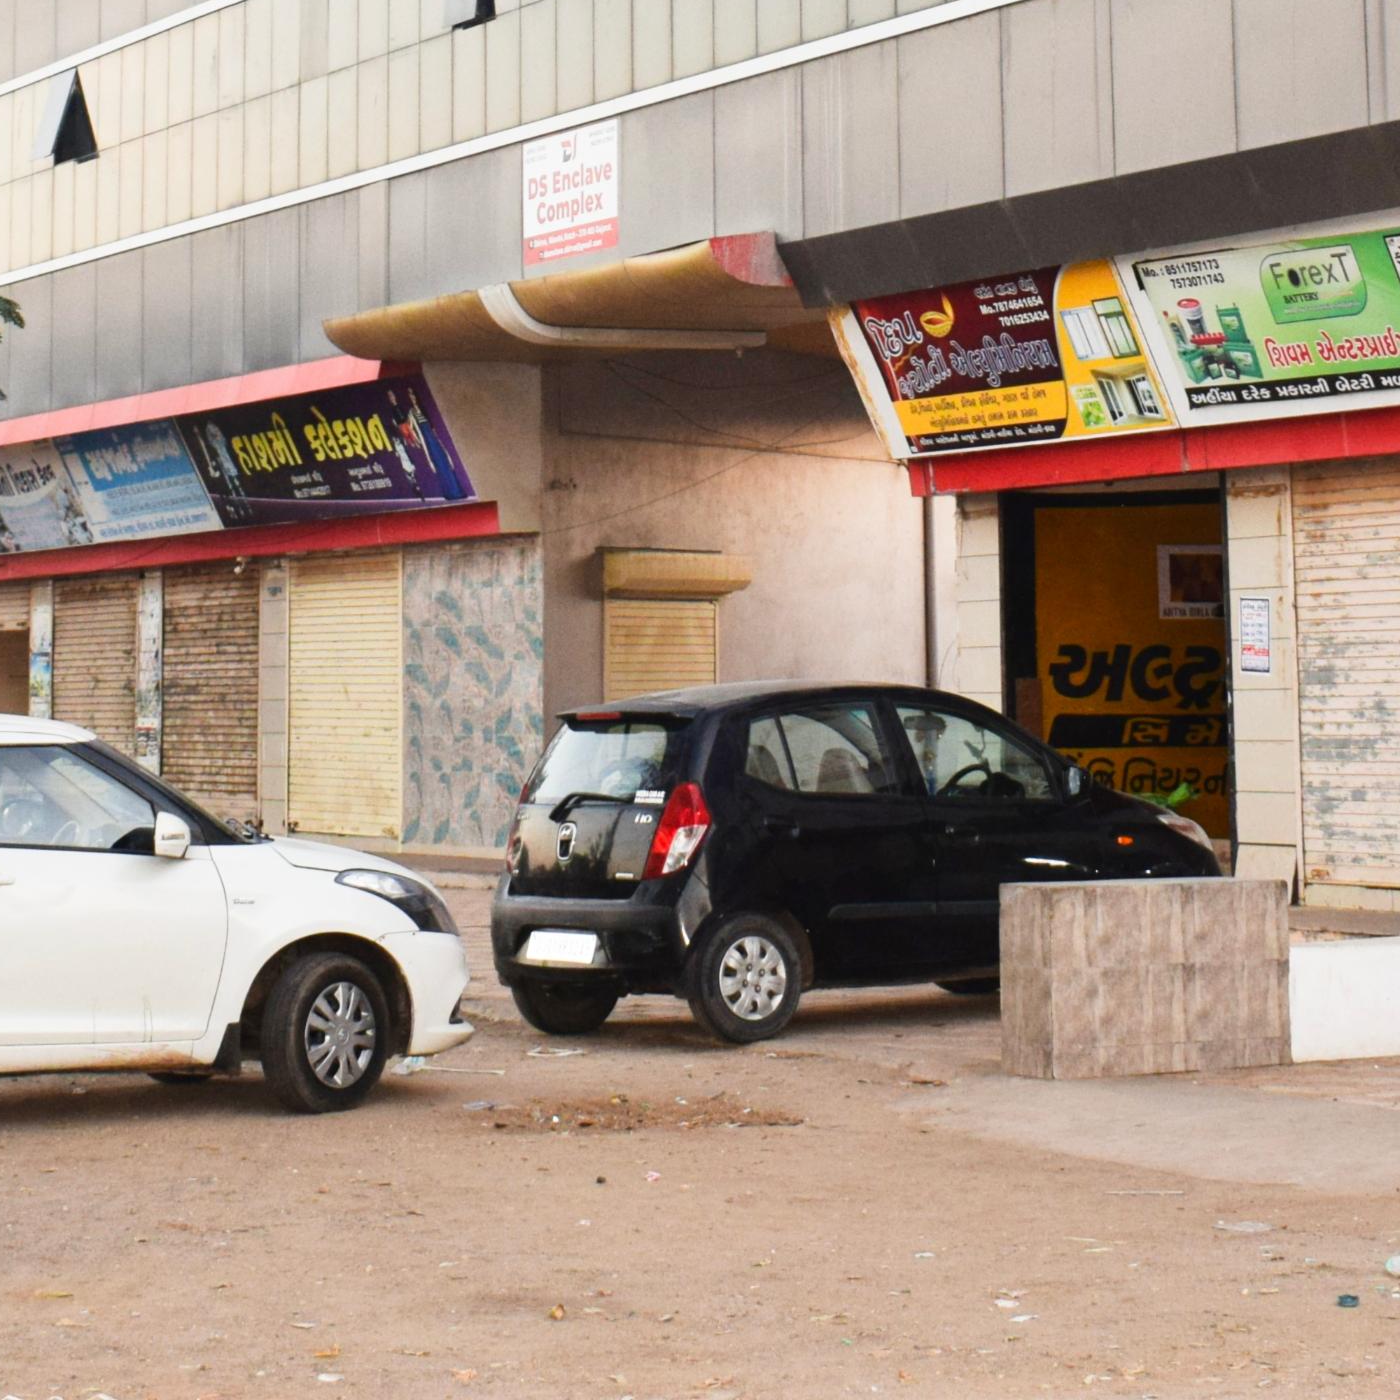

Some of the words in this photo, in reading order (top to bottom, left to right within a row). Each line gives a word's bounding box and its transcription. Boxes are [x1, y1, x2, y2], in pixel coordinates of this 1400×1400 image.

[528, 174, 548, 200] DS
[552, 162, 612, 194] Enclave
[537, 191, 603, 225] Complex
[1283, 291, 1319, 305] BATTERY
[1264, 335, 1313, 368] શિવમ
[1242, 383, 1271, 402] દરેક
[1335, 373, 1376, 394] બેટરી
